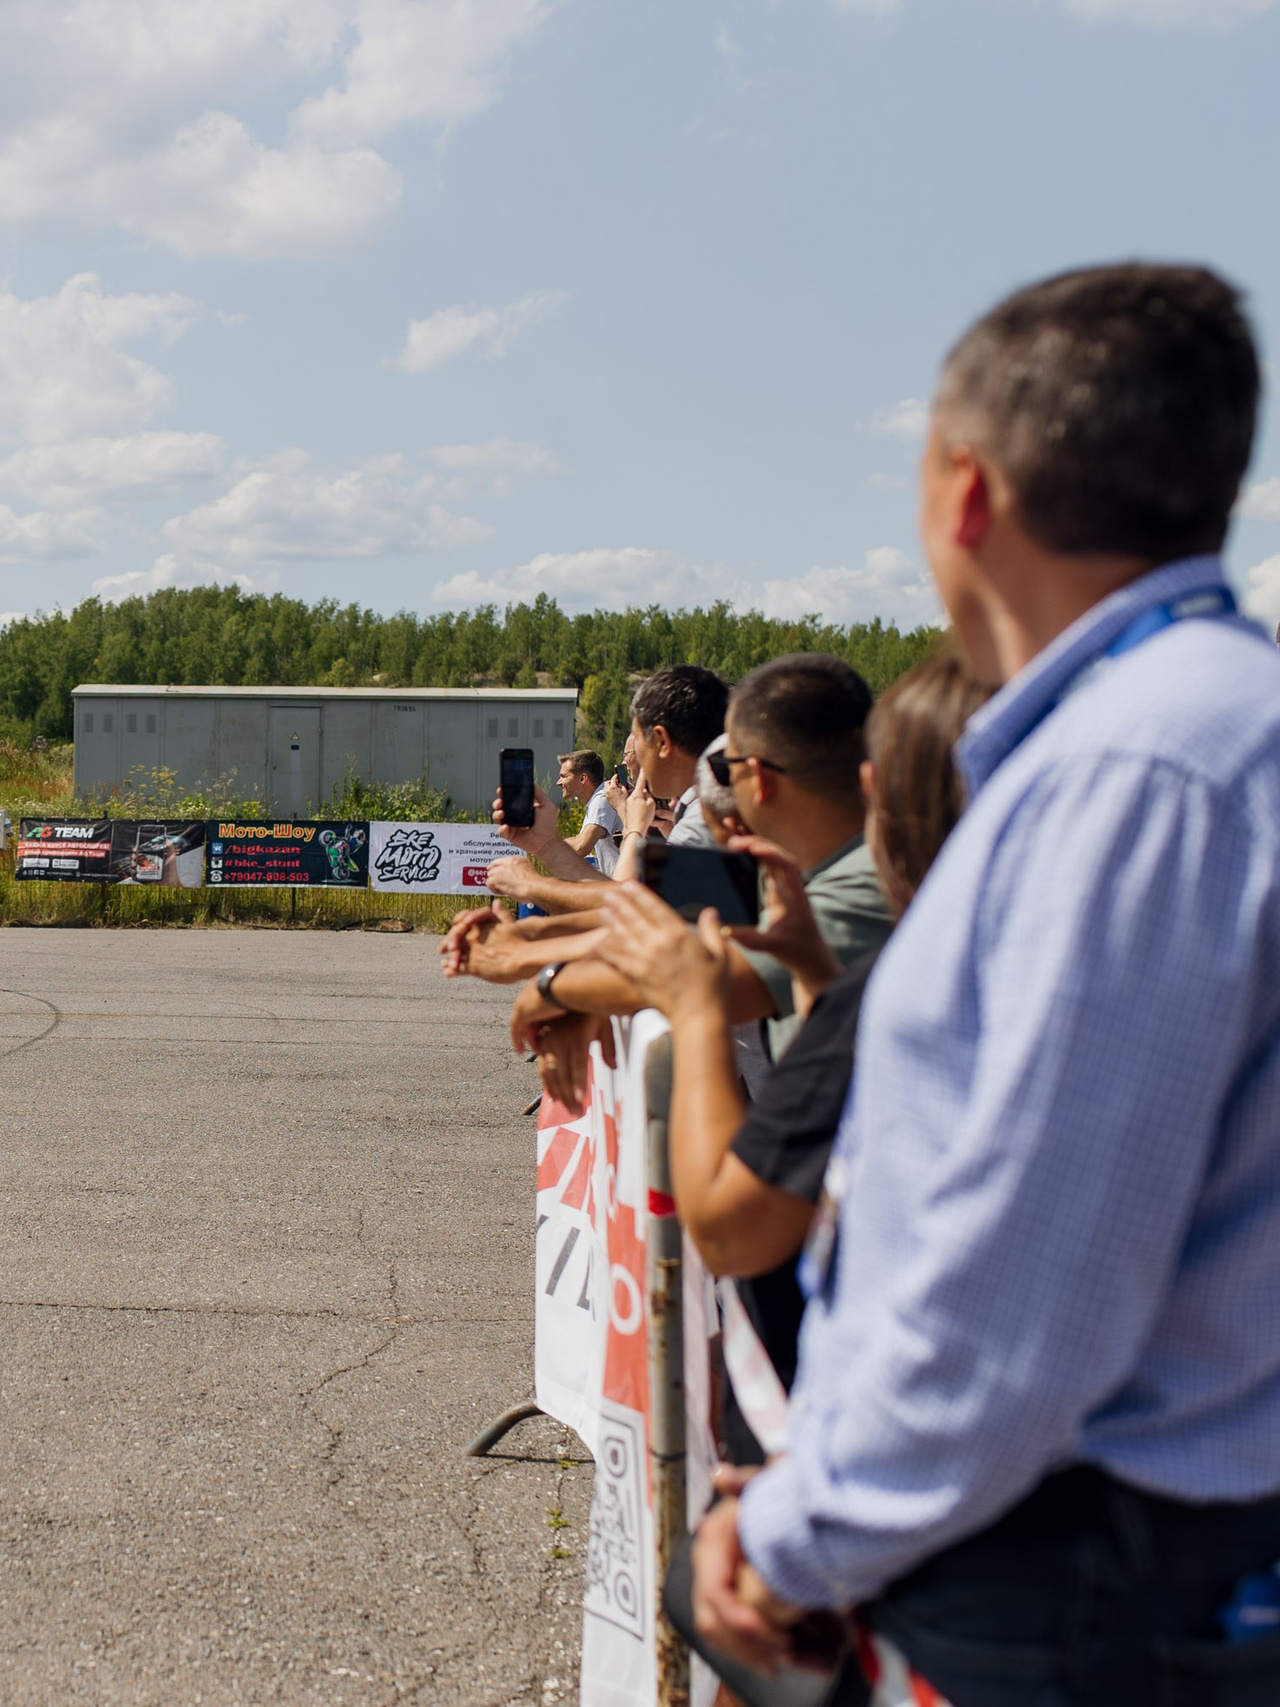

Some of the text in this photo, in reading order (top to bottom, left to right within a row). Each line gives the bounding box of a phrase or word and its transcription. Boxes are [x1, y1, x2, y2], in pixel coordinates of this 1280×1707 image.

[54, 827, 95, 839] TEAM
[219, 823, 316, 842] Мото-Шоу
[387, 829, 433, 847] BKE
[224, 845, 301, 855] /bigkazan
[375, 846, 441, 869] MOTO
[224, 872, 310, 882] +79047-608-503
[378, 866, 440, 884] SERVICE
